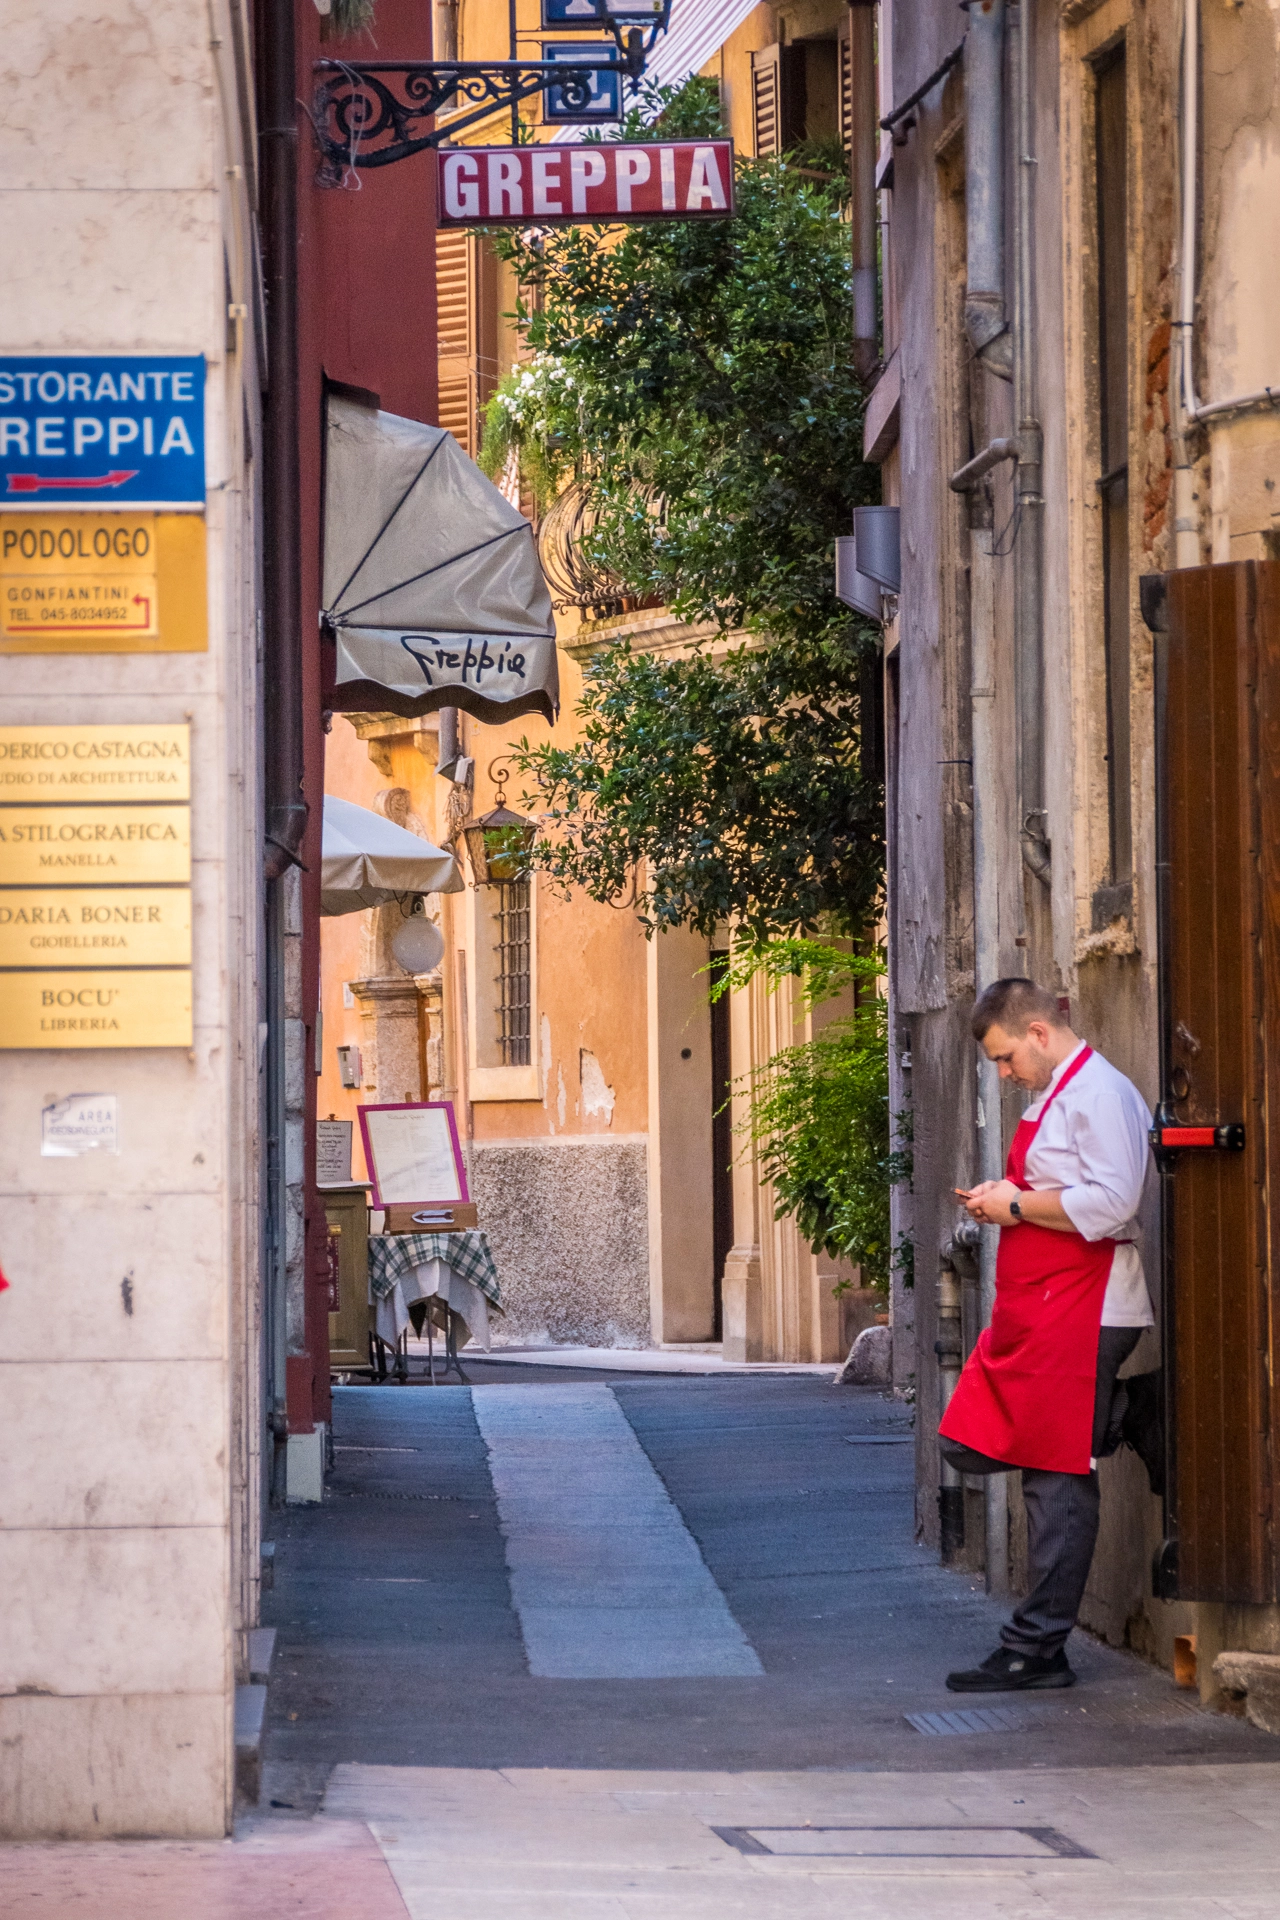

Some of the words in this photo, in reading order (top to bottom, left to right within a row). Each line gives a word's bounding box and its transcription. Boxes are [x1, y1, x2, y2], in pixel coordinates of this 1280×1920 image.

[443, 146, 728, 219] GREPPIA
[0, 370, 195, 403] STORANTE
[0, 415, 195, 456] REPPIA
[2, 528, 150, 559] PODOLOGO
[7, 586, 129, 602] GONFIANTINI
[40, 606, 128, 621] 045-8034952
[400, 635, 526, 686] Greppia
[72, 741, 182, 759] CASTAGNA
[38, 771, 54, 785] DI
[58, 770, 179, 785] ARCHITETTURA
[12, 823, 179, 842] STILOGRAFICA
[39, 853, 117, 867] MANELLA
[0, 906, 71, 924] DARIA
[81, 905, 162, 923] BONER
[30, 935, 127, 949] GIOIELLERIA
[40, 1017, 119, 1031] LIBRERIA
[78, 1110, 112, 1123] AREA
